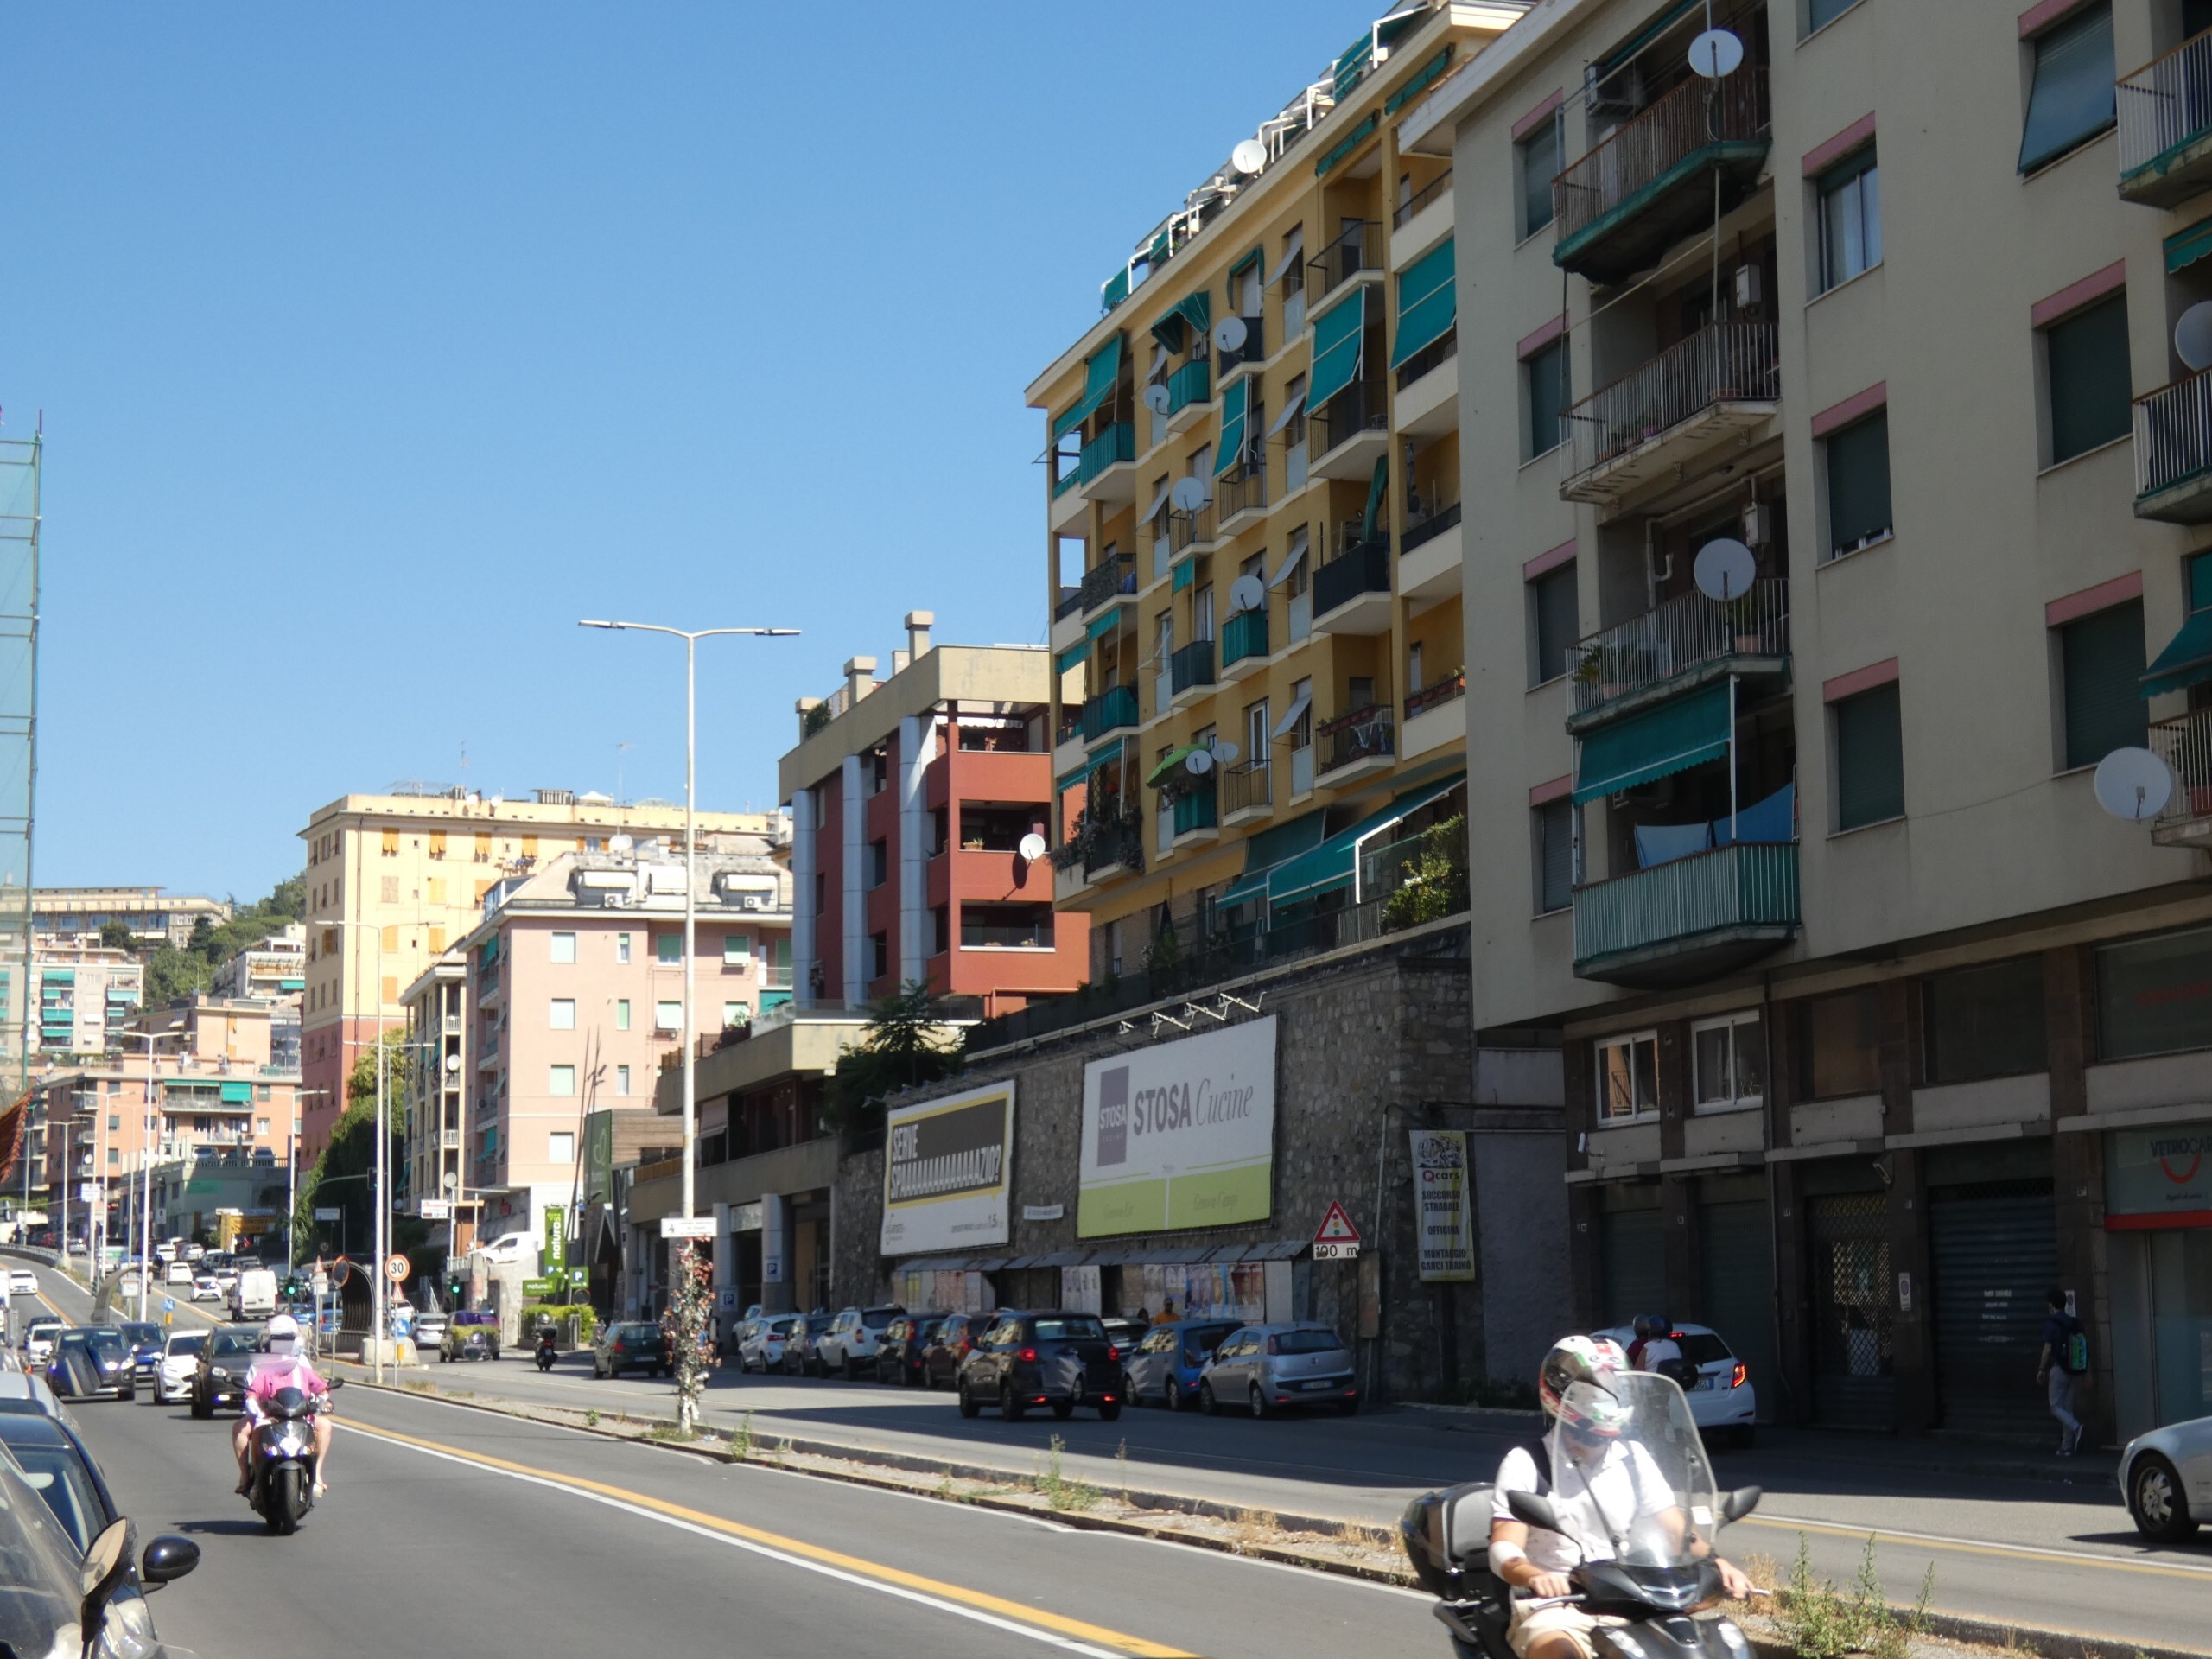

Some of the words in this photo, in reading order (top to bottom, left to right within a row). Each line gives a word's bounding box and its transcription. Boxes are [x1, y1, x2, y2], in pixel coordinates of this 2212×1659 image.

[1134, 1083, 1192, 1135] STOSA
[1196, 1073, 1254, 1127] Cucine
[1100, 1104, 1127, 1129] STOSA
[893, 1124, 919, 1161] SERVE
[1422, 1170, 1459, 1183] Qcars
[1422, 1190, 1461, 1200] SOCCORSO
[1424, 1202, 1460, 1212] STRADALE
[1427, 1225, 1460, 1236] OFFICINA
[1347, 1247, 1358, 1256] m
[1424, 1249, 1466, 1259] MONTAGGIO
[391, 1262, 404, 1274] 30
[1421, 1260, 1444, 1271] GANCI
[1445, 1260, 1471, 1271] TRAINO
